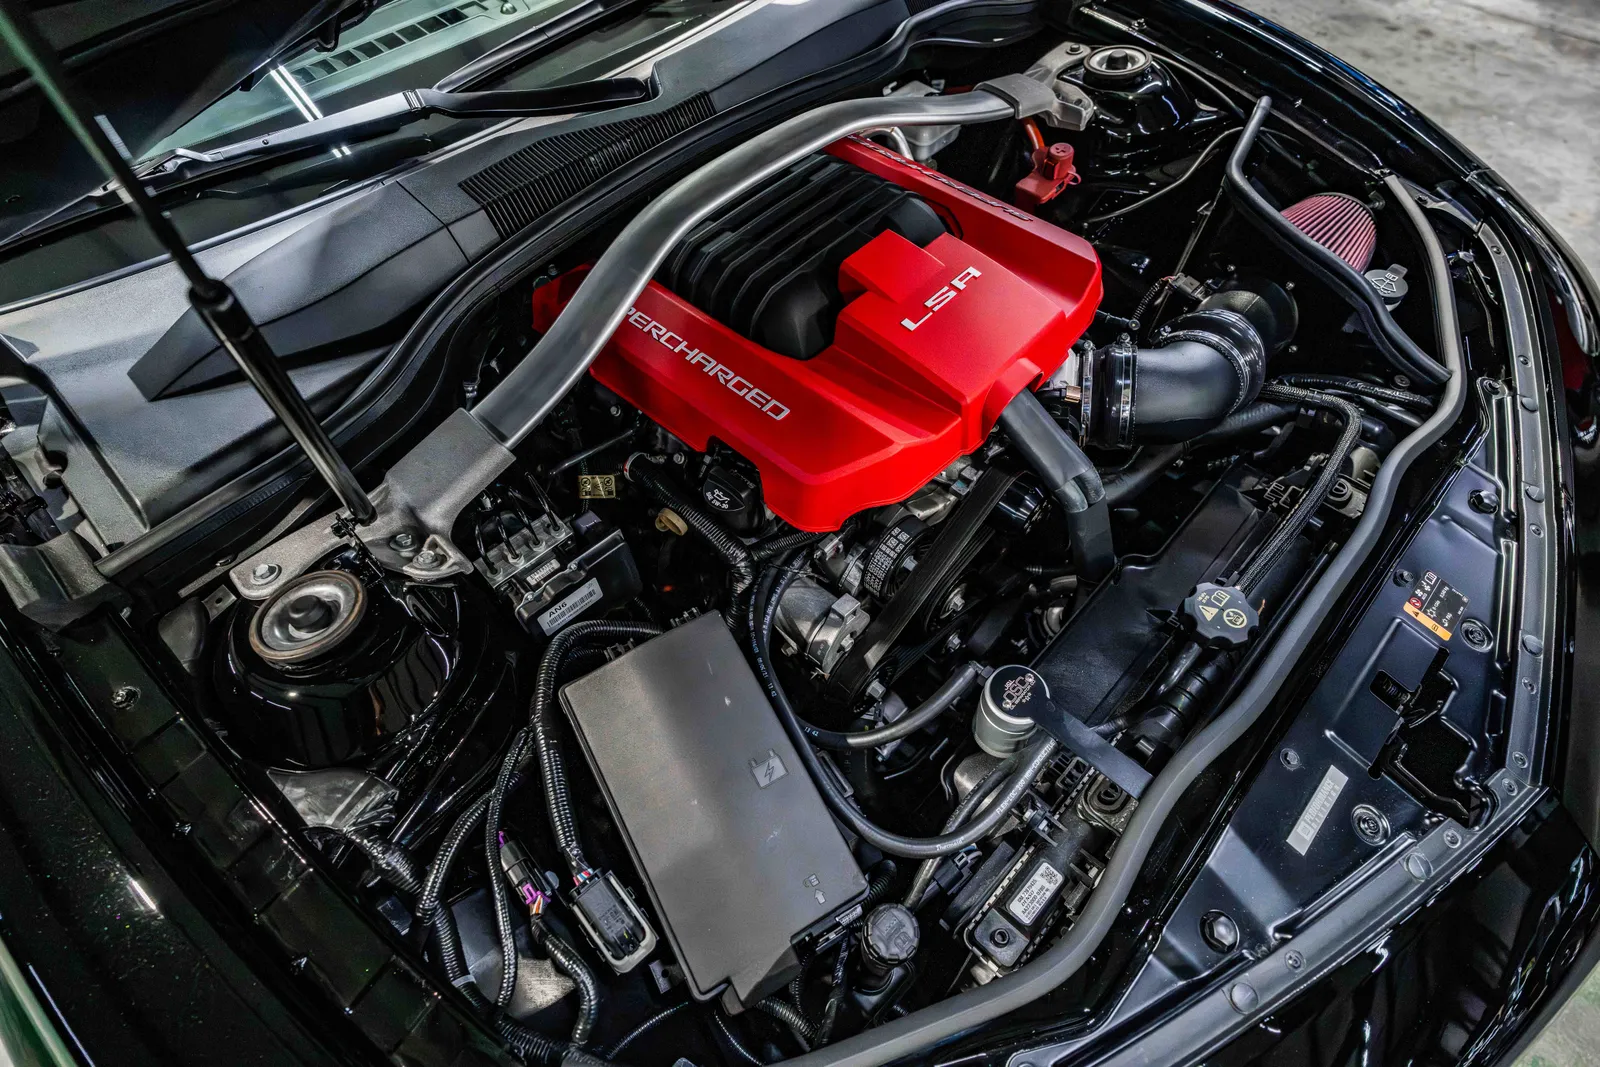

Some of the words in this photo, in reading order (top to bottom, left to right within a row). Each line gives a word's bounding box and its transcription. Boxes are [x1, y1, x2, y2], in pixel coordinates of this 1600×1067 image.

[900, 266, 982, 332] LSA
[711, 499, 729, 509] 5W-30
[548, 601, 568, 618] AN6
[1002, 675, 1030, 704] OSC
[1304, 777, 1335, 823] PERFORMANCE
[1310, 783, 1340, 830] DIVISION
